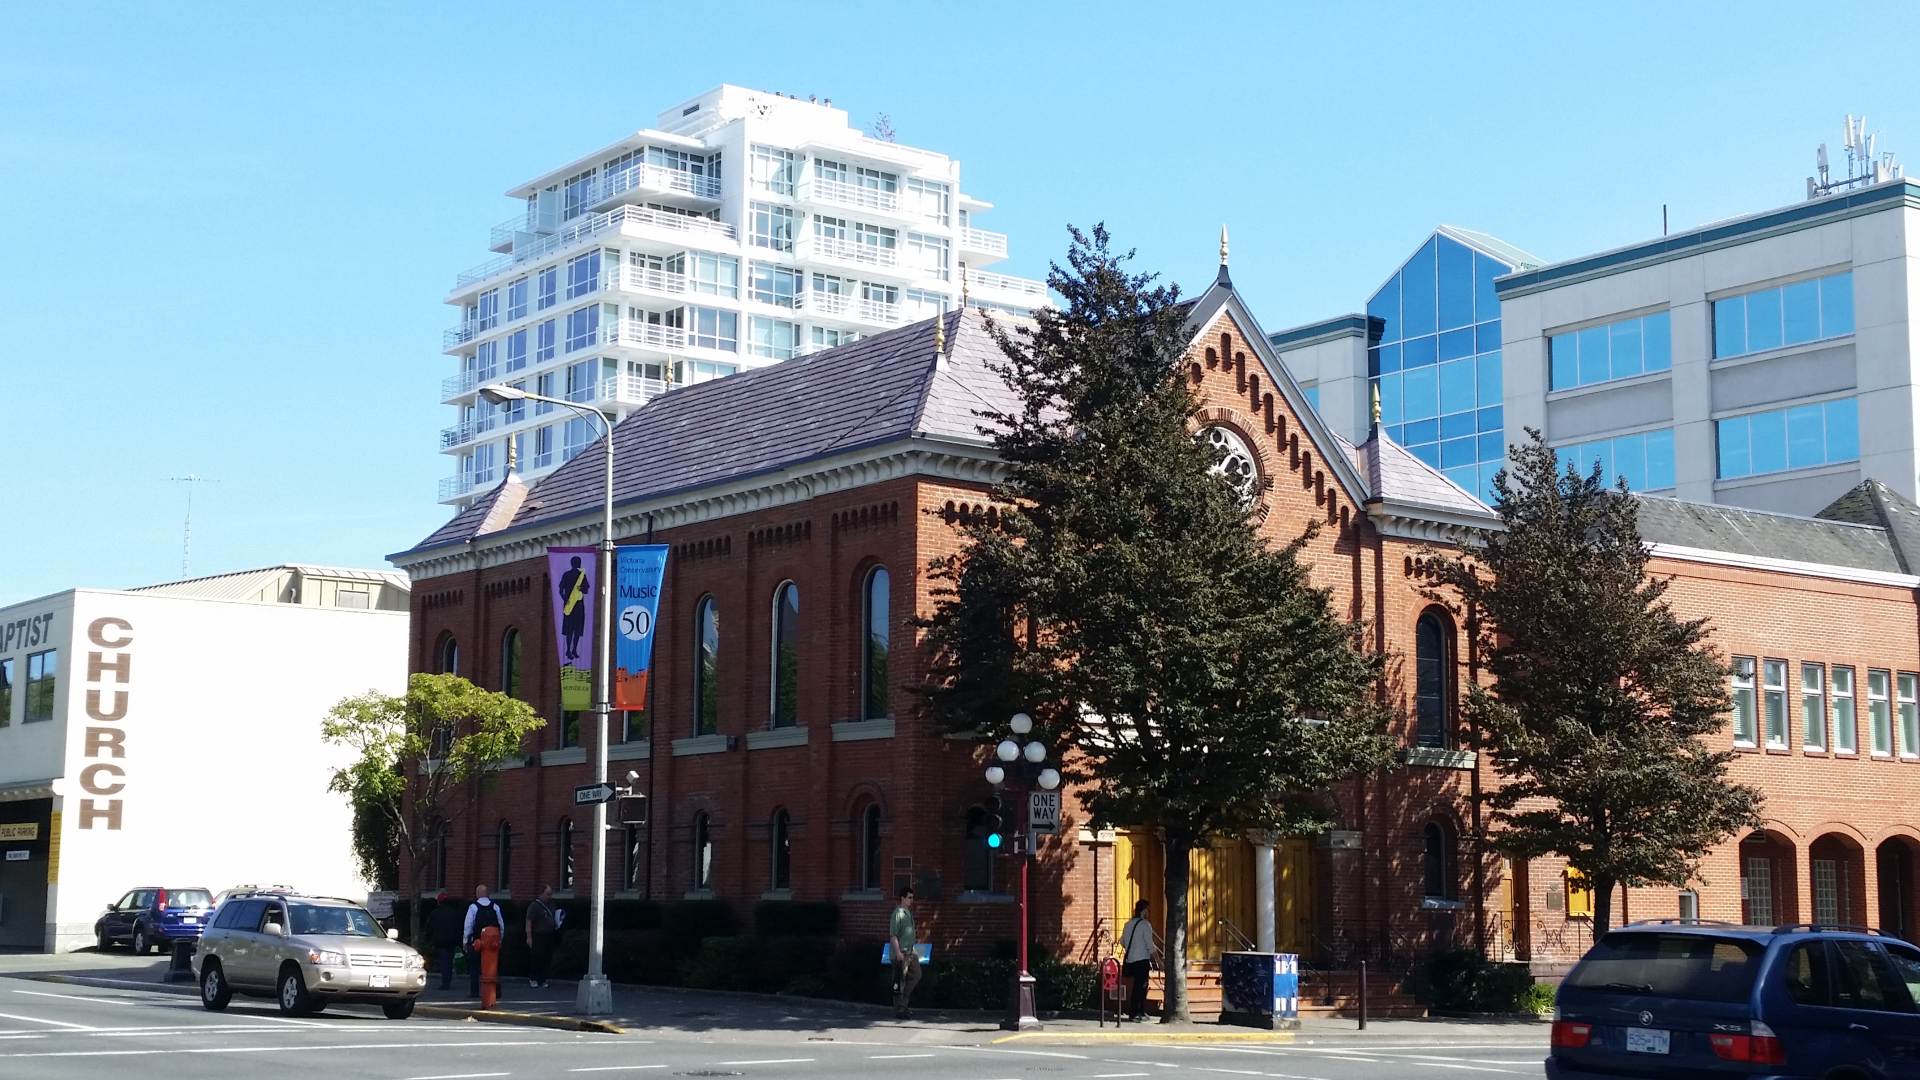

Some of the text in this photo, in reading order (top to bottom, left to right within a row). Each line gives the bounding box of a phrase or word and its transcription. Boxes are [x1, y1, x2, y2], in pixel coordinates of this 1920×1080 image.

[620, 585, 658, 599] Music
[622, 611, 650, 636] 50
[78, 616, 134, 831] CHURCH
[580, 789, 602, 800] ONE WAY
[1033, 794, 1056, 807] ONE
[1033, 807, 1056, 820] WAY
[1713, 1023, 1742, 1032] X5
